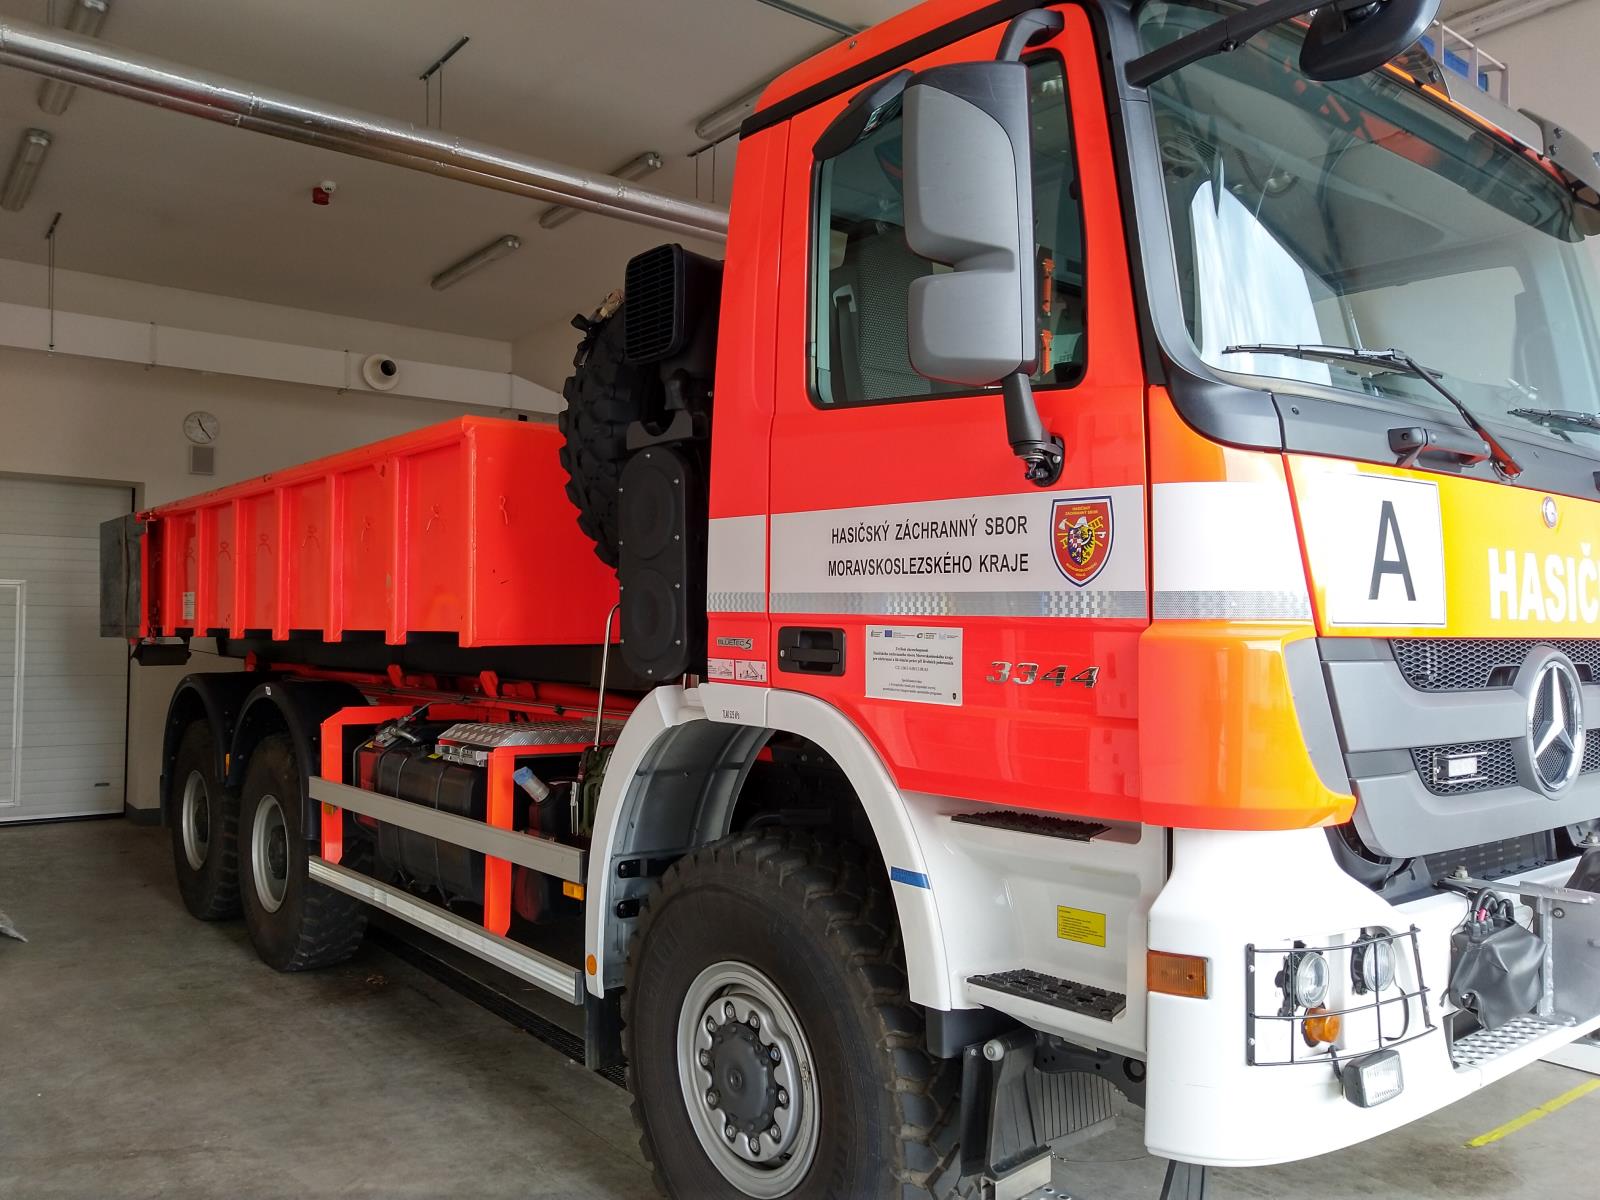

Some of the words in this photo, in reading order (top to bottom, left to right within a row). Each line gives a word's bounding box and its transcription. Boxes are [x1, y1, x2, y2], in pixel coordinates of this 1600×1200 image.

[831, 520, 889, 544] HASIČSKÝ
[895, 514, 978, 541] ZÁCHRANNÝ
[984, 515, 1028, 536] SBOR
[828, 552, 972, 577] MORAVSKOSLEZSKÉHO
[979, 553, 1029, 573] KRAJE
[1368, 500, 1416, 601] A
[1488, 541, 1600, 624] HASIČ
[985, 661, 1100, 689] 3344
